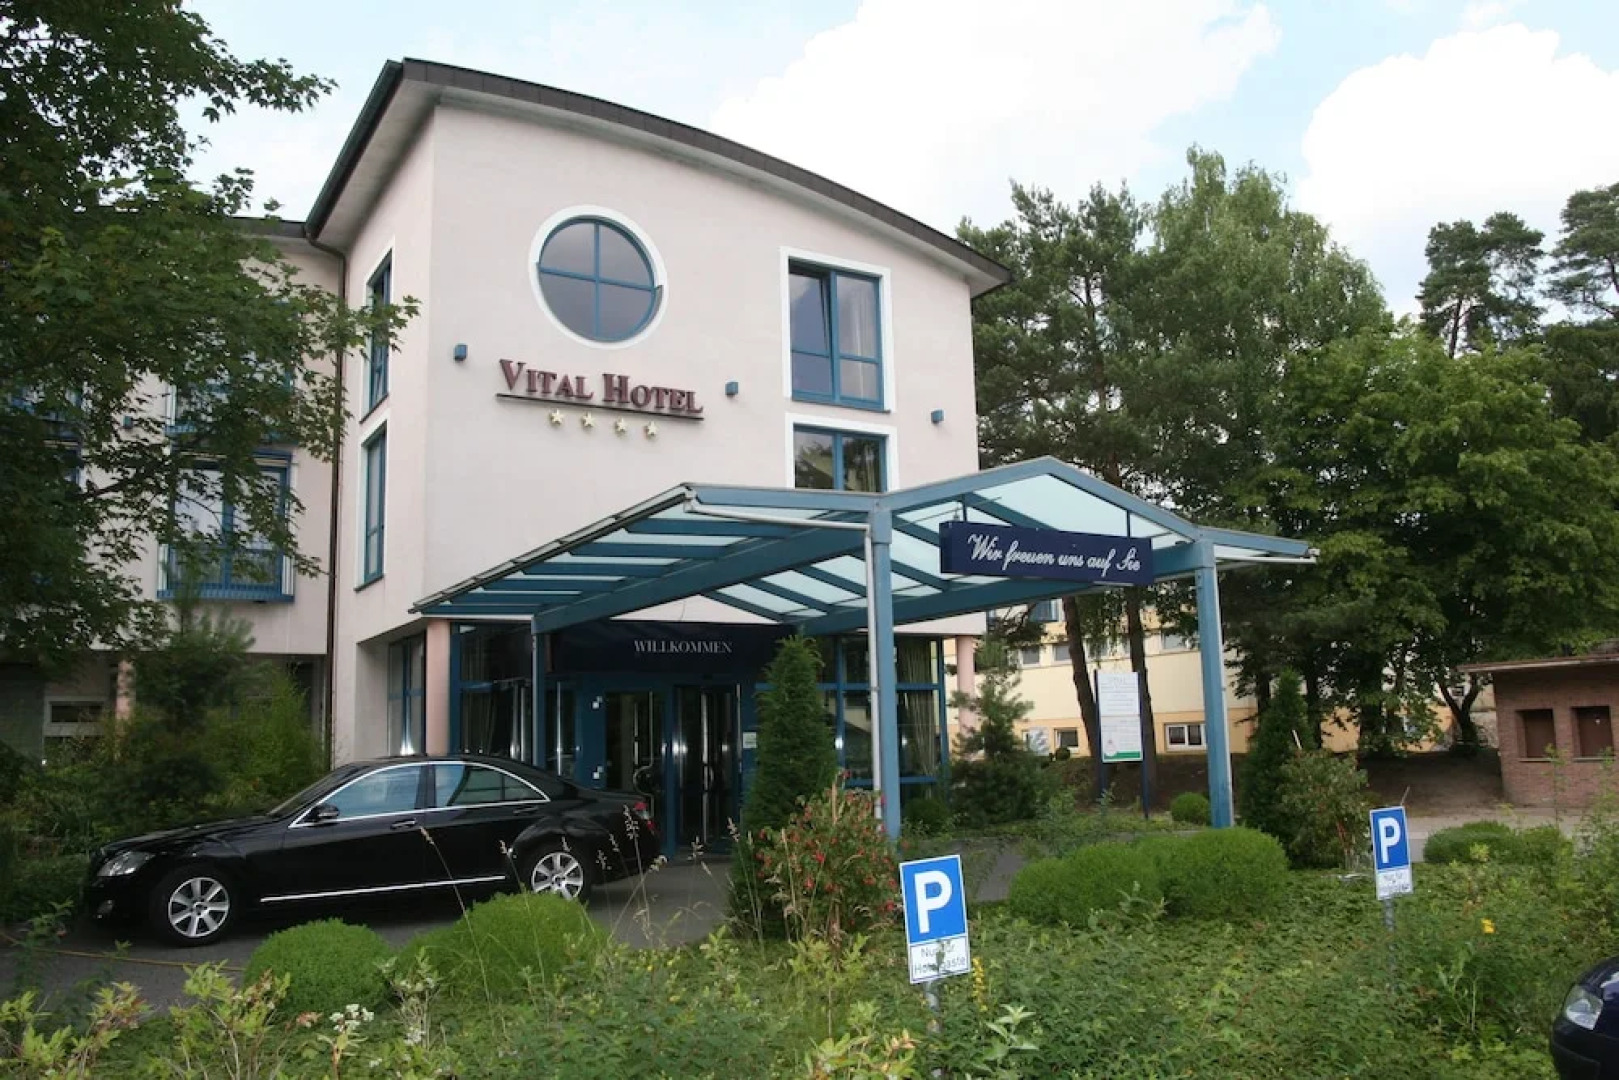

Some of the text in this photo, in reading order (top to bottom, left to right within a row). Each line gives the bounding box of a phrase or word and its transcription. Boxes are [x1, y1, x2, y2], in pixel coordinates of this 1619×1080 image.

[499, 358, 704, 414] VITAL HOTEL
[967, 533, 1141, 578] Wir freuen uns auf Sie
[633, 639, 733, 654] WILLKOMMEN
[1378, 817, 1401, 864] P
[914, 870, 953, 934] P
